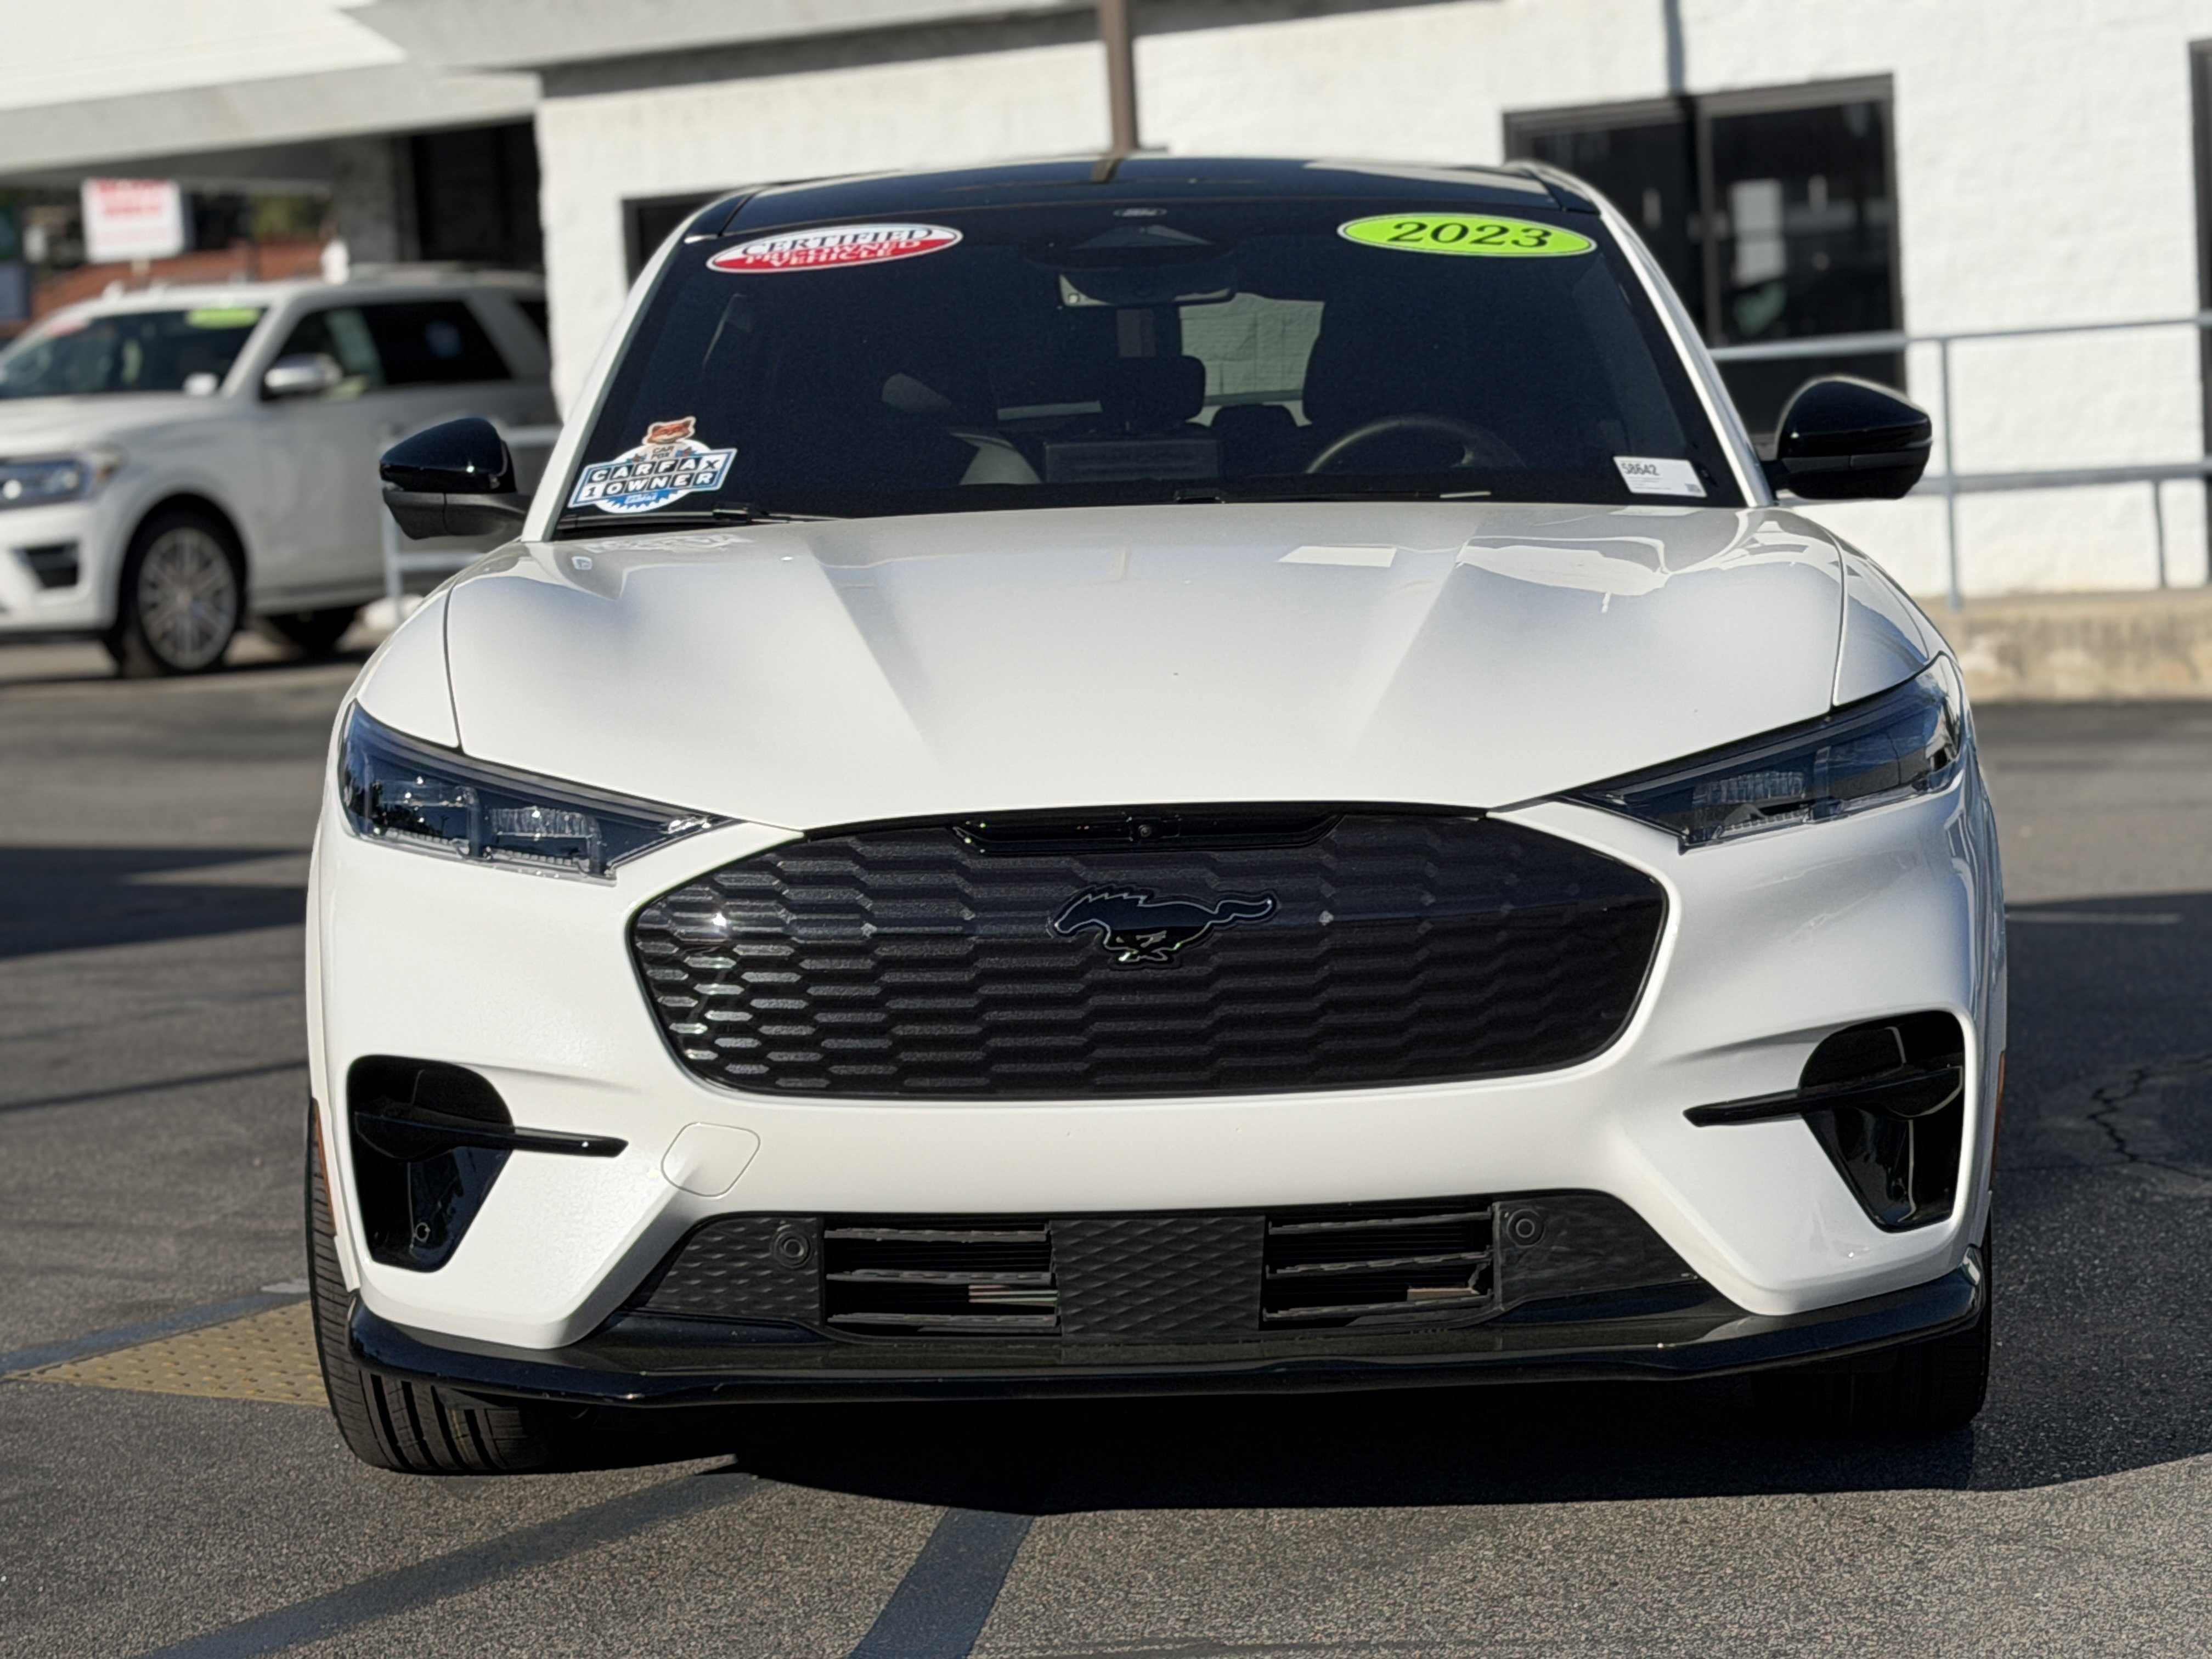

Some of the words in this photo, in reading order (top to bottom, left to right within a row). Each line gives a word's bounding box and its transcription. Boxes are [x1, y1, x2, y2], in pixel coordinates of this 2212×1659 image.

[742, 228, 933, 256] CERTIFIED
[1387, 221, 1553, 248] 2023
[769, 249, 893, 267] VEHICLE
[652, 445, 674, 454] CAR
[591, 459, 721, 482] CARFAX
[585, 487, 598, 497] 1
[606, 472, 714, 495] OWNER
